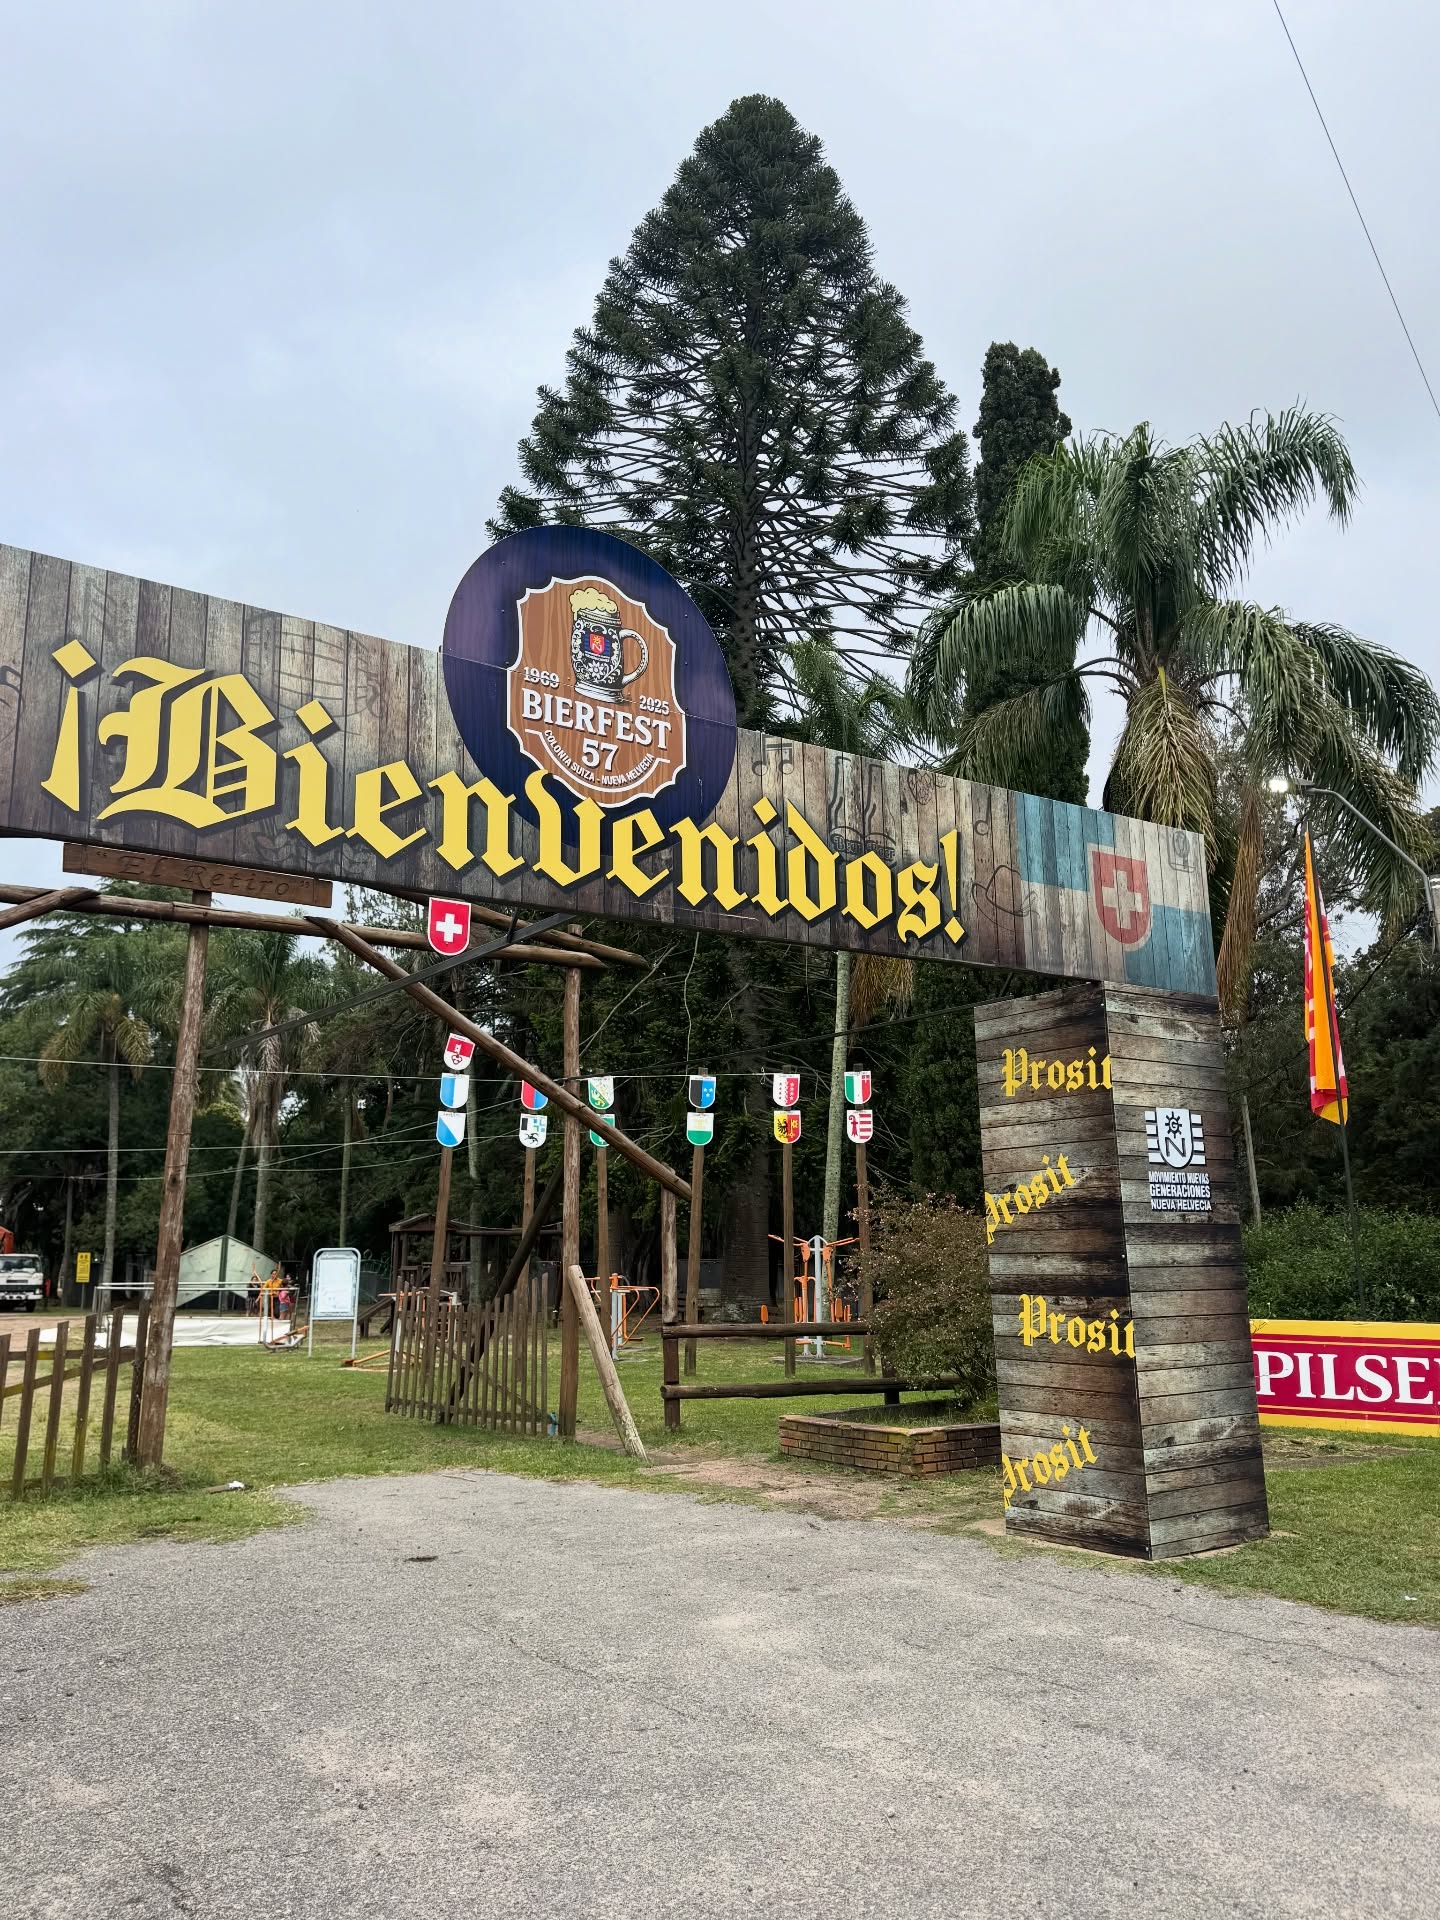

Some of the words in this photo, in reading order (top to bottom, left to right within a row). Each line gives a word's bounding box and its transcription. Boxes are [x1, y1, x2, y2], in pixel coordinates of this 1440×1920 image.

[523, 666, 560, 688] 1969
[522, 687, 672, 750] BIERFEST
[639, 695, 670, 715] 2025
[544, 730, 572, 767] COLONIA
[571, 762, 595, 783] SUIZA
[602, 774, 626, 786] NUEVA
[627, 753, 655, 783] HELVECIA
[581, 738, 619, 771] 57
[41, 639, 966, 944] ¡Bienvenidos!
[1001, 1046, 1113, 1097] Prosit
[1148, 1171, 1186, 1184] MOVIMIENTO
[1187, 1173, 1209, 1185] NUEVAS
[1150, 1184, 1211, 1198] GENERACIONES
[1151, 1199, 1175, 1210] NUEVA
[1178, 1199, 1212, 1211] HELVECIA
[1018, 1293, 1136, 1359] Prosit
[1253, 1350, 1440, 1405] PILSE
